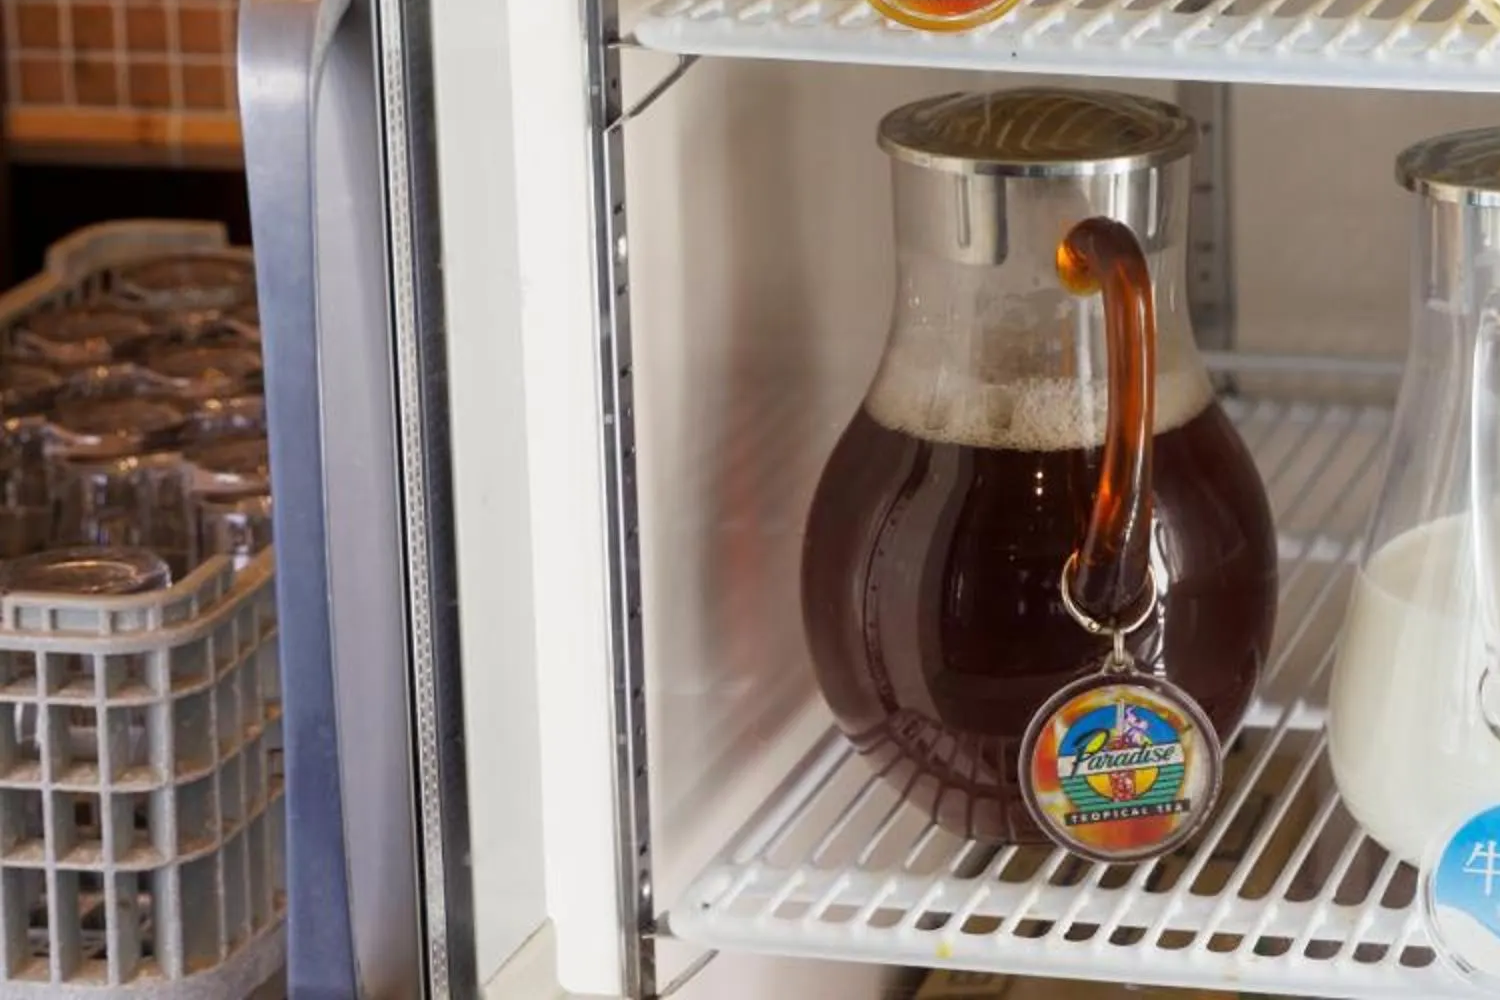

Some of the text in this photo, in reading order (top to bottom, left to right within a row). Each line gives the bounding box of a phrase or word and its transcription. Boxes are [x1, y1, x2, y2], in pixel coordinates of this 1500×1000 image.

[1070, 728, 1176, 779] Paradise
[1071, 802, 1184, 825] TROPICAL TEA
